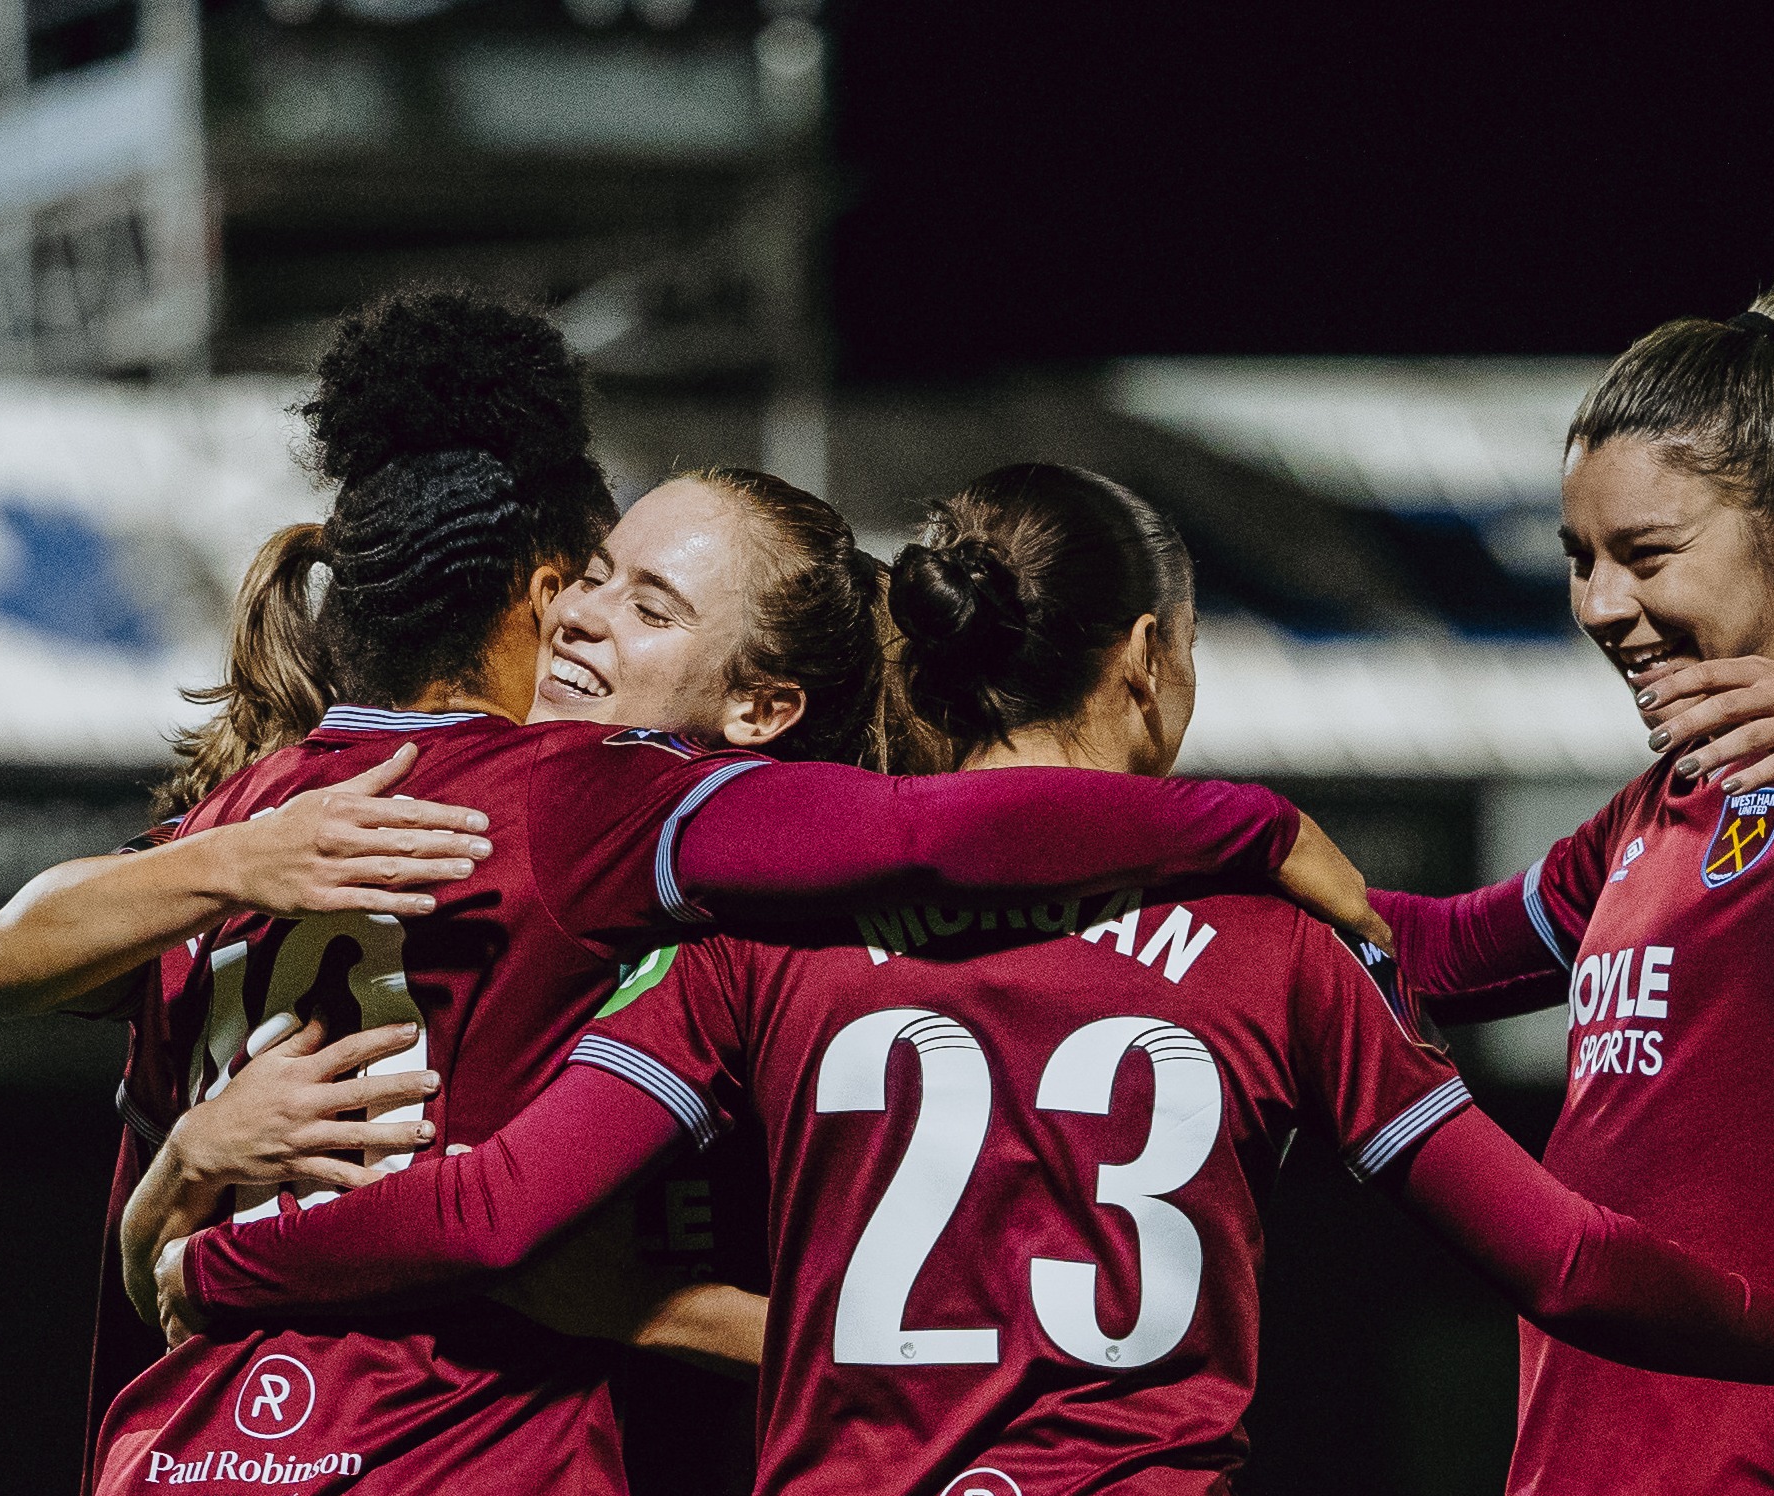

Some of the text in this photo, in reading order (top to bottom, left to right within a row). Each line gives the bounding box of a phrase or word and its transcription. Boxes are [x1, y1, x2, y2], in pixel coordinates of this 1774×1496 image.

[1730, 794, 1757, 808] WEST
[1738, 805, 1768, 816] UNITED
[1574, 1029, 1664, 1080] SPORTS
[815, 1006, 1224, 1370] 23
[145, 1450, 362, 1485] Paul Robinson
